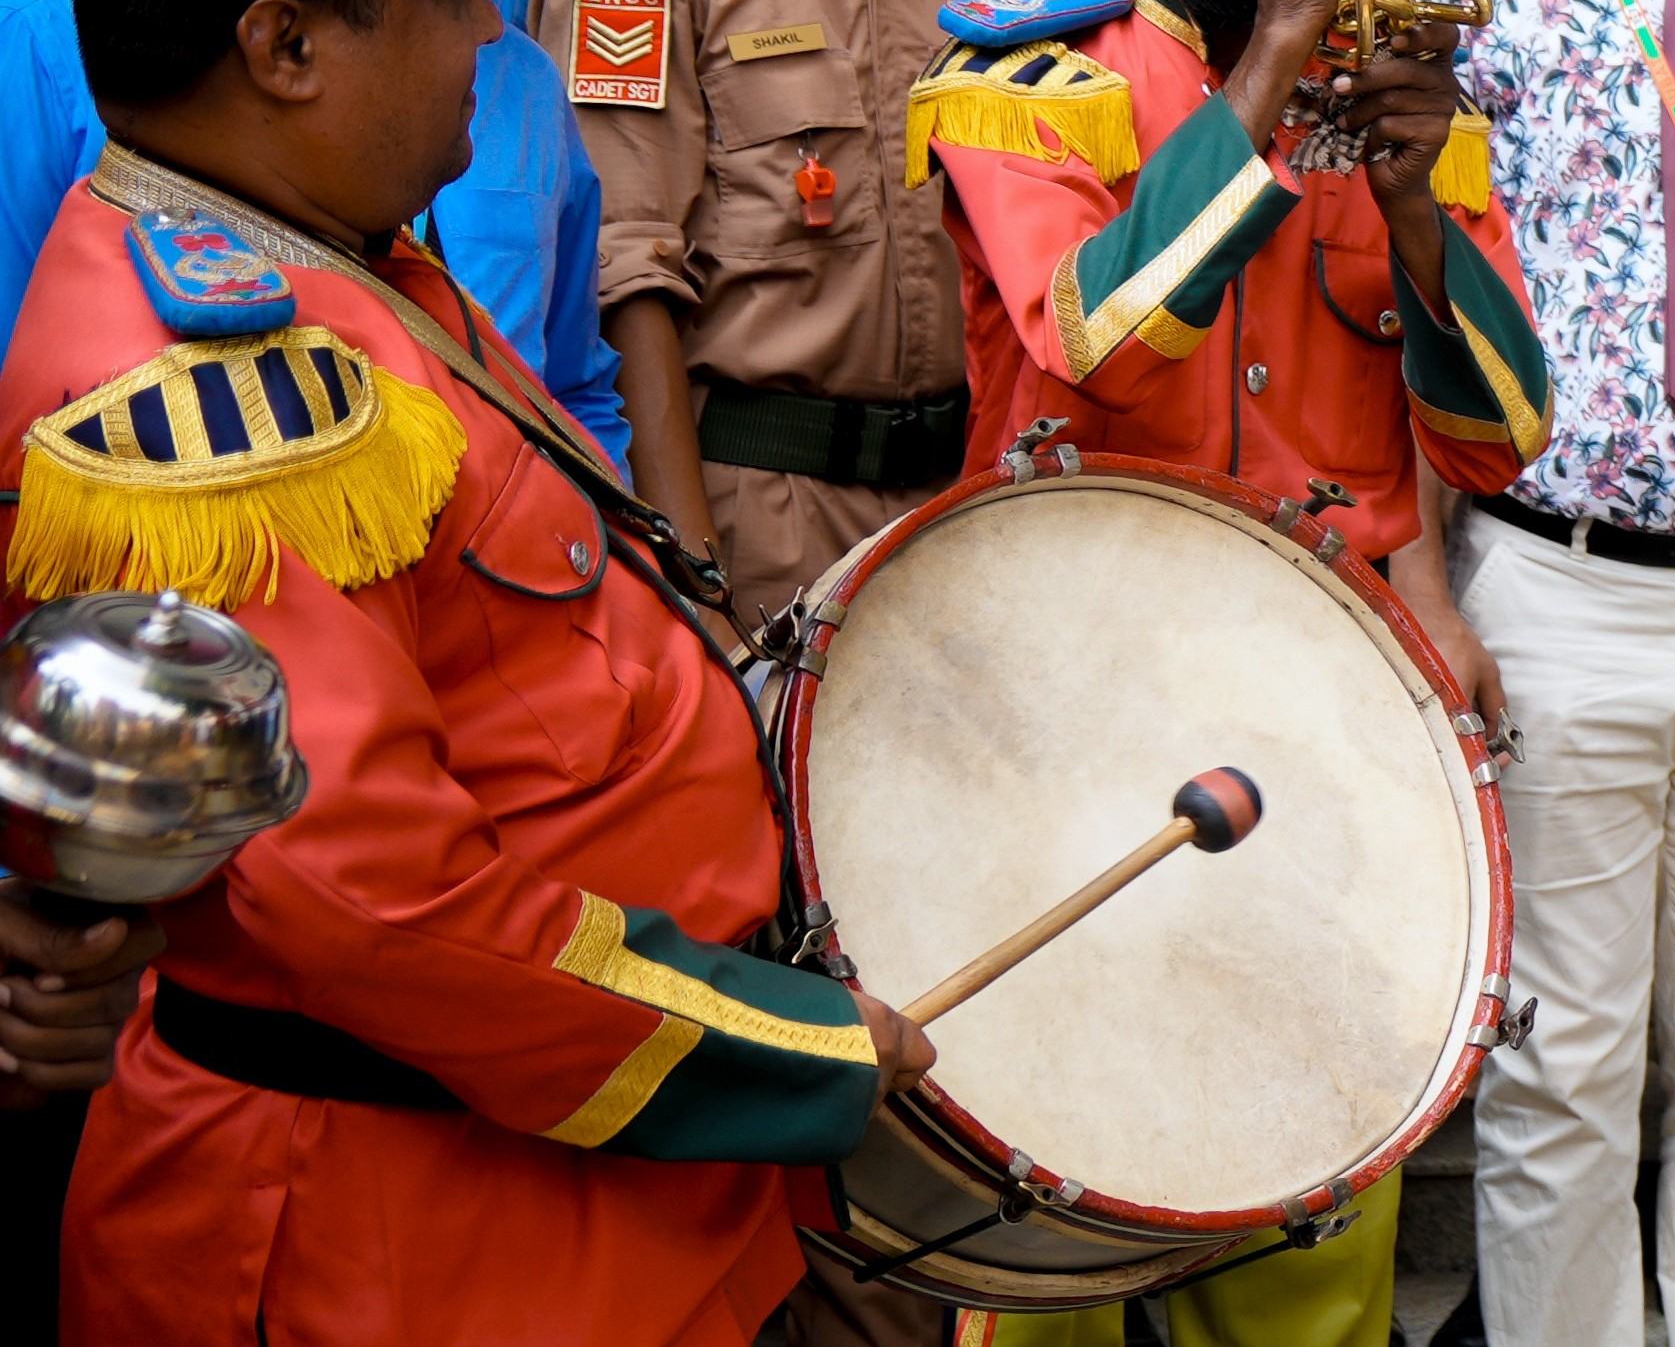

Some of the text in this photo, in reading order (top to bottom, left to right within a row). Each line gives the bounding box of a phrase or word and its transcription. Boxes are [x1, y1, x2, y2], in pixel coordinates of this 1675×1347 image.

[752, 32, 804, 51] SHAKIL
[575, 80, 660, 101] CADET SGT
